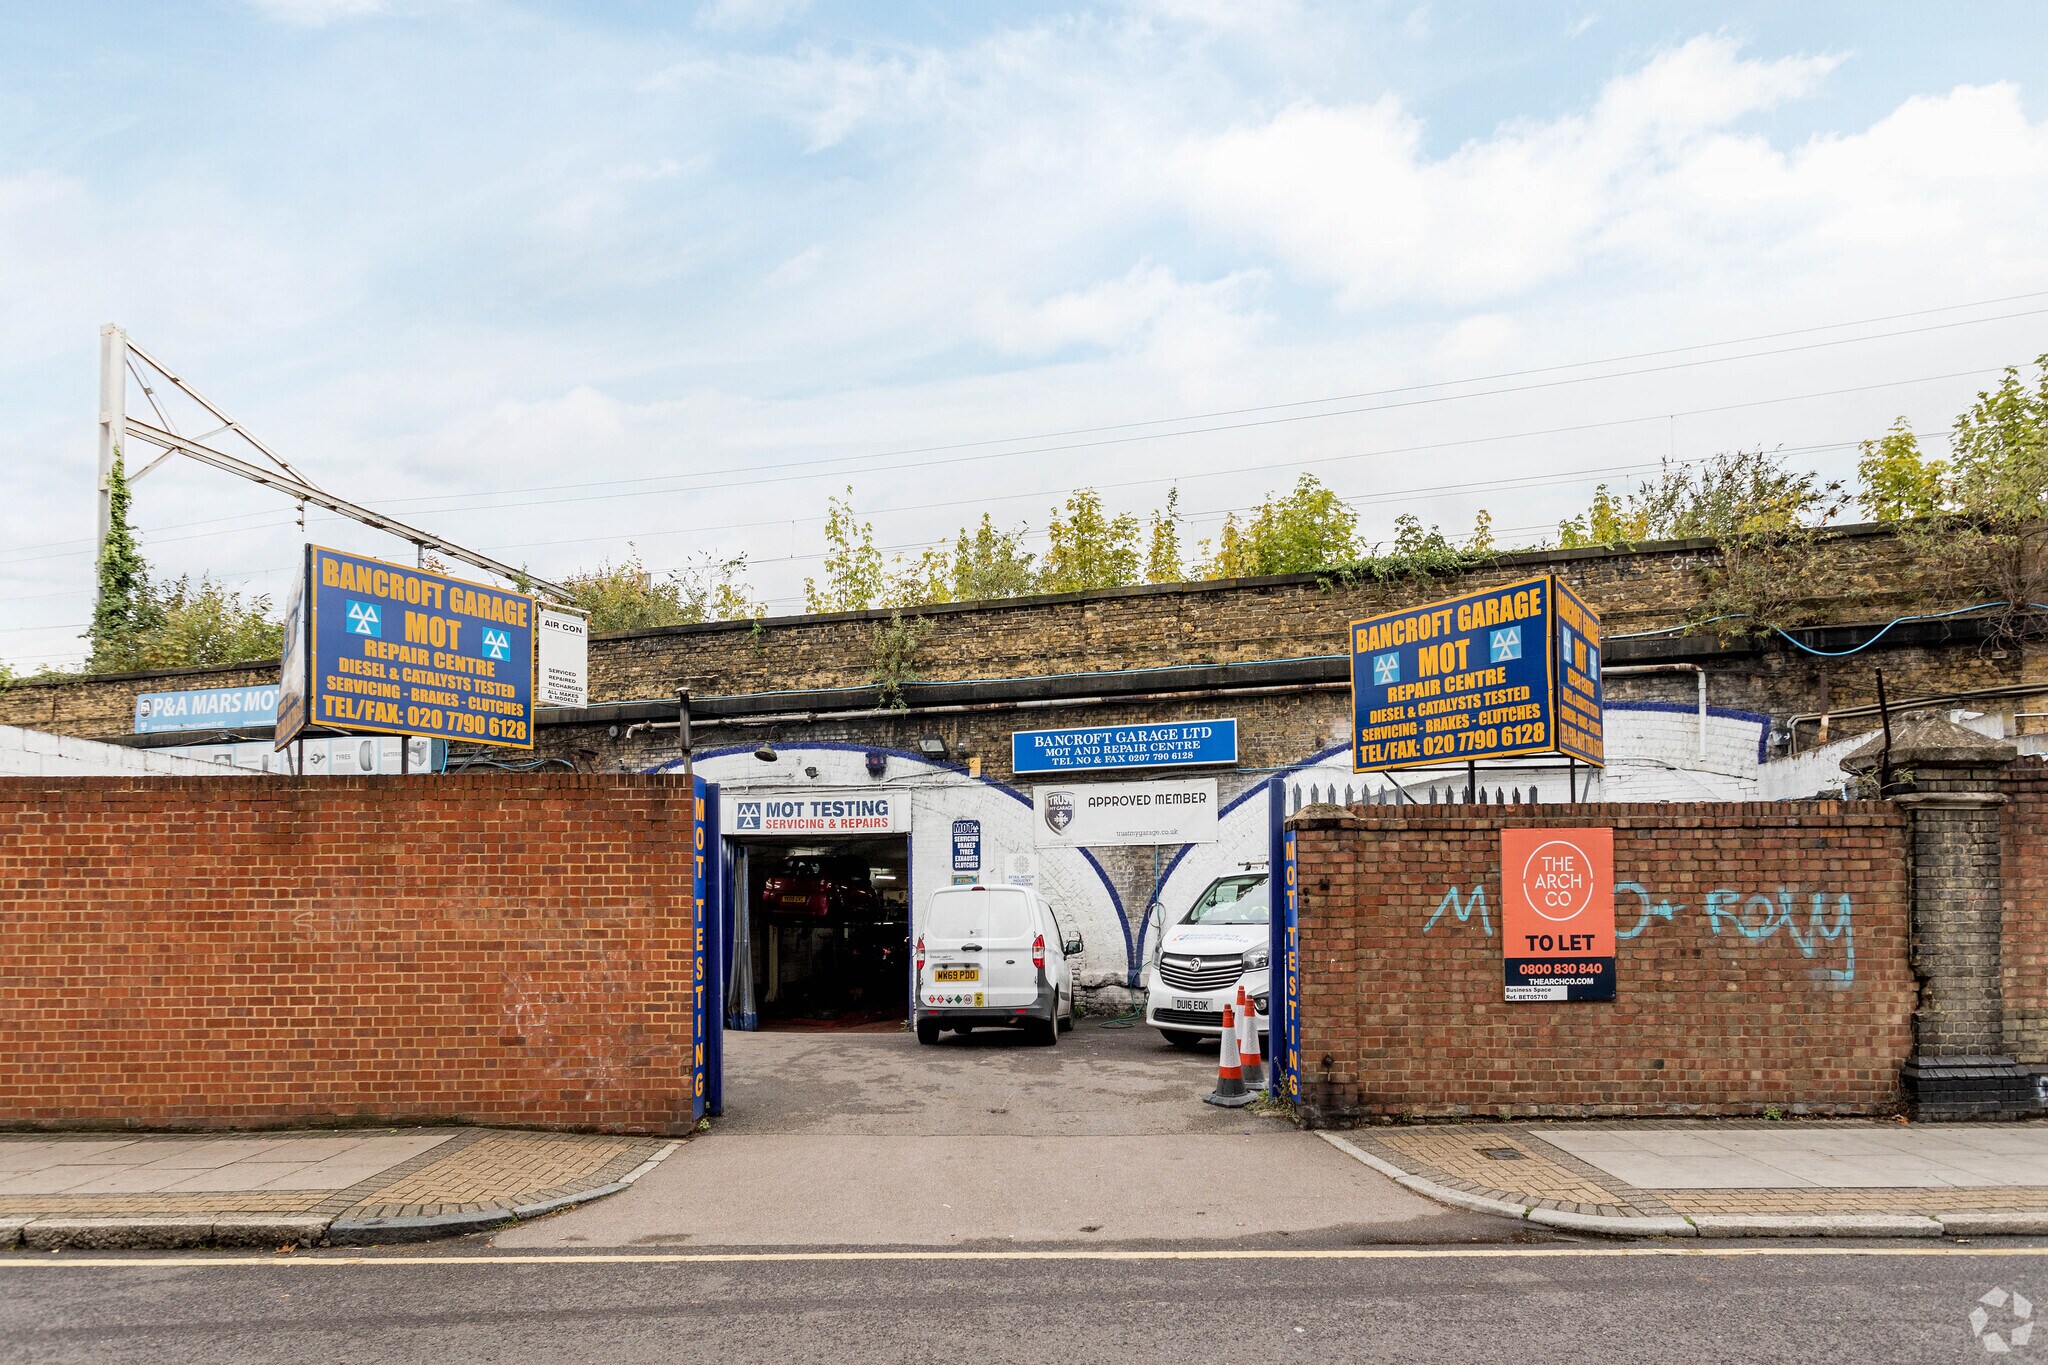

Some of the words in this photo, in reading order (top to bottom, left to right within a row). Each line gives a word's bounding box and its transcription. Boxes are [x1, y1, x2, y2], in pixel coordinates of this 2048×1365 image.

[322, 558, 445, 609] BANCROFT
[450, 587, 528, 628] GARAGE
[544, 620, 559, 629] AIR
[562, 624, 582, 634] CON
[1356, 608, 1453, 654] BANCROFT
[1457, 587, 1542, 632] GARAGE
[404, 611, 462, 650] MOT
[364, 639, 430, 666] REPAIR
[434, 651, 496, 677] CENTRE
[1418, 638, 1471, 678] MOT
[339, 657, 386, 679] DIESEL
[389, 667, 399, 681] &
[402, 668, 471, 693] CATALYSTS
[473, 678, 515, 698] TESTED
[548, 668, 577, 677] SERVICED
[548, 675, 576, 684] REPAIRED
[548, 682, 583, 692] RECHARGED
[1387, 677, 1441, 703] REPAIR
[1444, 666, 1507, 693] CENTRE
[327, 675, 401, 699] SERVICING
[411, 687, 459, 707] BRAKES
[468, 697, 524, 717] CLUTCHES
[554, 696, 578, 704] MODELS
[559, 691, 579, 699] MAKES
[152, 695, 188, 718] P&A
[191, 693, 242, 715] MARS
[1369, 707, 1405, 725] DIESEL
[1407, 706, 1416, 719] &
[1417, 694, 1482, 717] CATALYSTS
[1484, 686, 1531, 702] TESTED
[322, 694, 404, 724] TEL/FAX:
[407, 706, 443, 729] 020
[447, 712, 485, 734] 7790
[489, 717, 527, 740] 6128
[1362, 721, 1417, 743] SERVICING
[1425, 713, 1470, 734] BRAKES
[1478, 703, 1541, 726] CLUTCHES
[1034, 732, 1112, 748] BANCROFT
[1116, 729, 1178, 743] GARAGE
[1182, 727, 1212, 740] LTD
[1360, 739, 1420, 764] TEL/FAX:
[1423, 734, 1455, 756] 020
[1458, 728, 1498, 752] 7790
[1501, 721, 1545, 746] 6128
[1045, 748, 1071, 757] MOT
[1074, 746, 1100, 755] AND
[1104, 744, 1147, 754] REPAIR
[1150, 741, 1200, 751] CENTRE
[1052, 757, 1073, 766] TEL
[1076, 756, 1091, 765] NO
[1094, 756, 1102, 764] &
[1105, 755, 1125, 764] FAX
[1128, 753, 1150, 762] 0207
[1153, 752, 1169, 761] 790
[1171, 751, 1194, 760] 6128
[766, 801, 804, 818] MOT
[810, 800, 889, 818] TESTING
[1088, 794, 1151, 808] APPROVED
[1155, 792, 1207, 805] MEMBER
[766, 818, 824, 829] SERVICING
[828, 818, 836, 829] &
[841, 817, 889, 828] REPAIRS
[953, 822, 974, 833] MOT
[695, 797, 704, 879] MOT
[1116, 828, 1178, 837] trustmygarage.co.uk
[1541, 856, 1574, 872] THE
[1286, 840, 1295, 910] MOT
[1535, 873, 1582, 889] ARCH
[1545, 891, 1572, 907] CO
[1525, 935, 1554, 951] TO
[1558, 934, 1595, 951] LET
[1519, 964, 1552, 975] 0800
[1554, 963, 1577, 974] 830
[1579, 963, 1603, 974] 840
[694, 898, 704, 1097] TESTING
[1176, 1000, 1192, 1010] DU16
[1194, 1000, 1208, 1010] EOK
[1287, 927, 1298, 1096] TESTING
